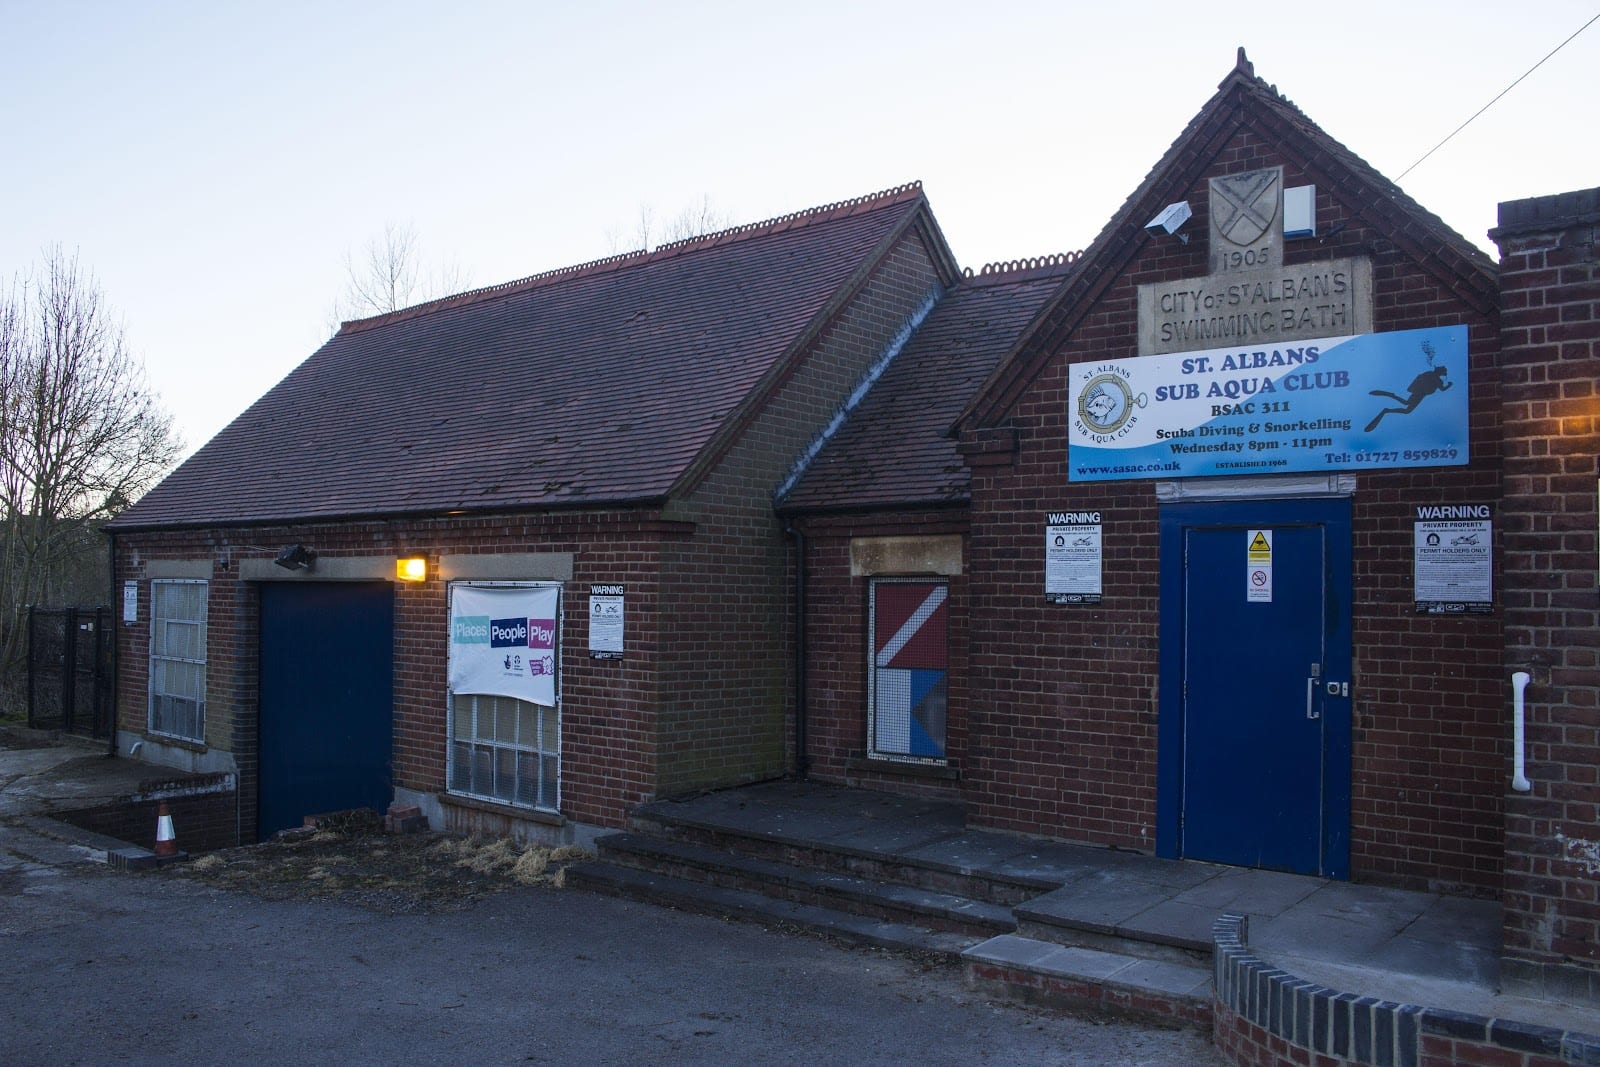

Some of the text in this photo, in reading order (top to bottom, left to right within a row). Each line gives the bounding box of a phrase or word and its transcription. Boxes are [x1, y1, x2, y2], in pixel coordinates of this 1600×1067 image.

[1223, 248, 1270, 271] 1905
[1160, 289, 1203, 314] CITY
[1160, 303, 1346, 343] SWIMMING BATH
[1181, 346, 1320, 375] ST. ALBANS
[1096, 364, 1131, 379] ALBANS
[1155, 370, 1350, 402] SUB AQUA CLUB
[1211, 401, 1290, 417] BSAC 311
[1074, 416, 1138, 444] SUB AQUA CLUB
[1156, 418, 1351, 439] Scuba Diving & Snorkelling
[1170, 440, 1244, 455] Wednesday
[1248, 439, 1279, 452] 8pm
[1291, 437, 1333, 449] 11pm
[1215, 461, 1267, 469] ESTABLISHED
[1324, 448, 1458, 464] Tel: 01727 859829
[1077, 461, 1181, 475] www.sasac.co.uk
[1048, 512, 1100, 524] WARNING
[1417, 505, 1490, 519] WARNING
[591, 585, 624, 595] WARNING
[456, 623, 554, 645] Places People Play
